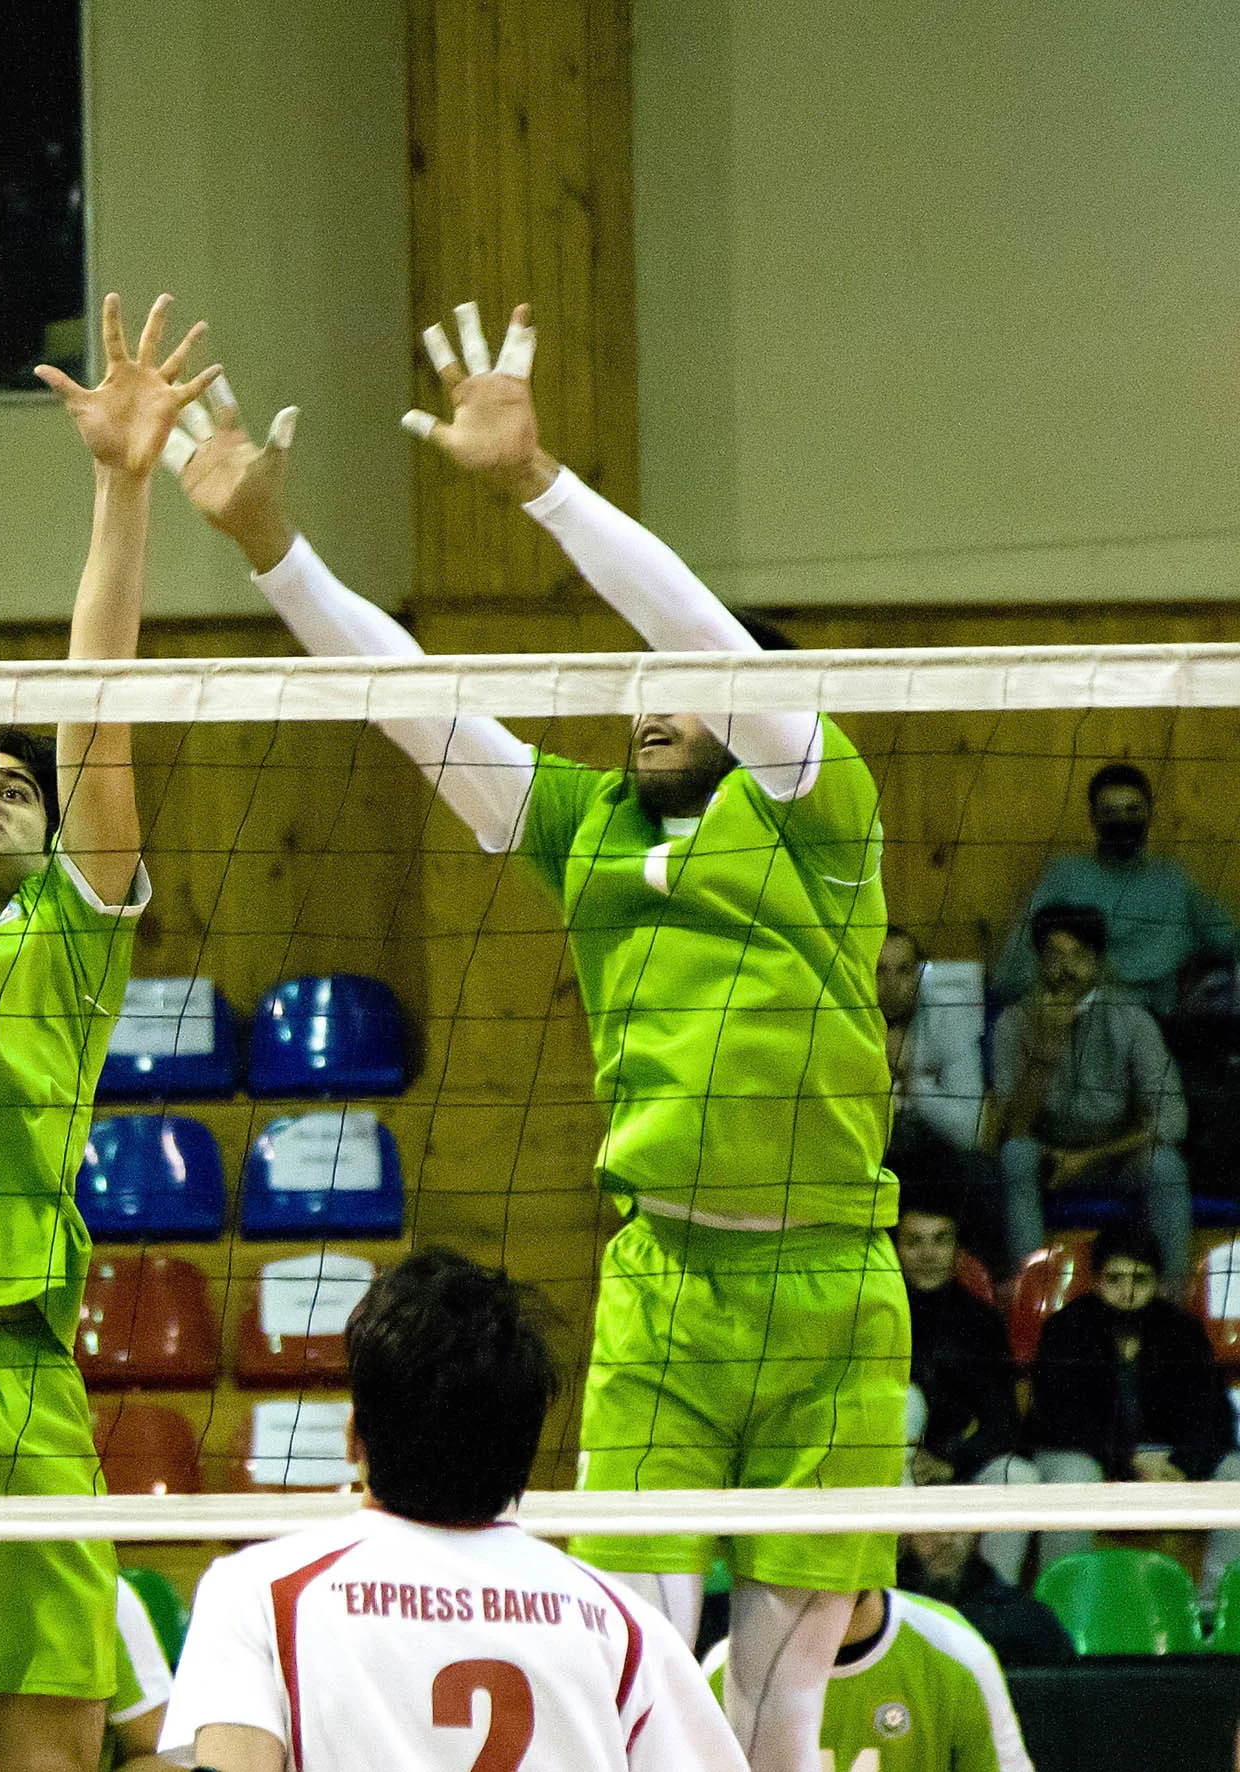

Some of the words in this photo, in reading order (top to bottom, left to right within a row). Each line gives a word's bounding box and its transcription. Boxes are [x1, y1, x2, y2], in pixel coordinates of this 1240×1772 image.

[331, 1581, 474, 1622] "EXPRESS
[482, 1586, 571, 1625] BAKU"
[577, 1598, 610, 1640] VK
[432, 1658, 535, 1772] 2
